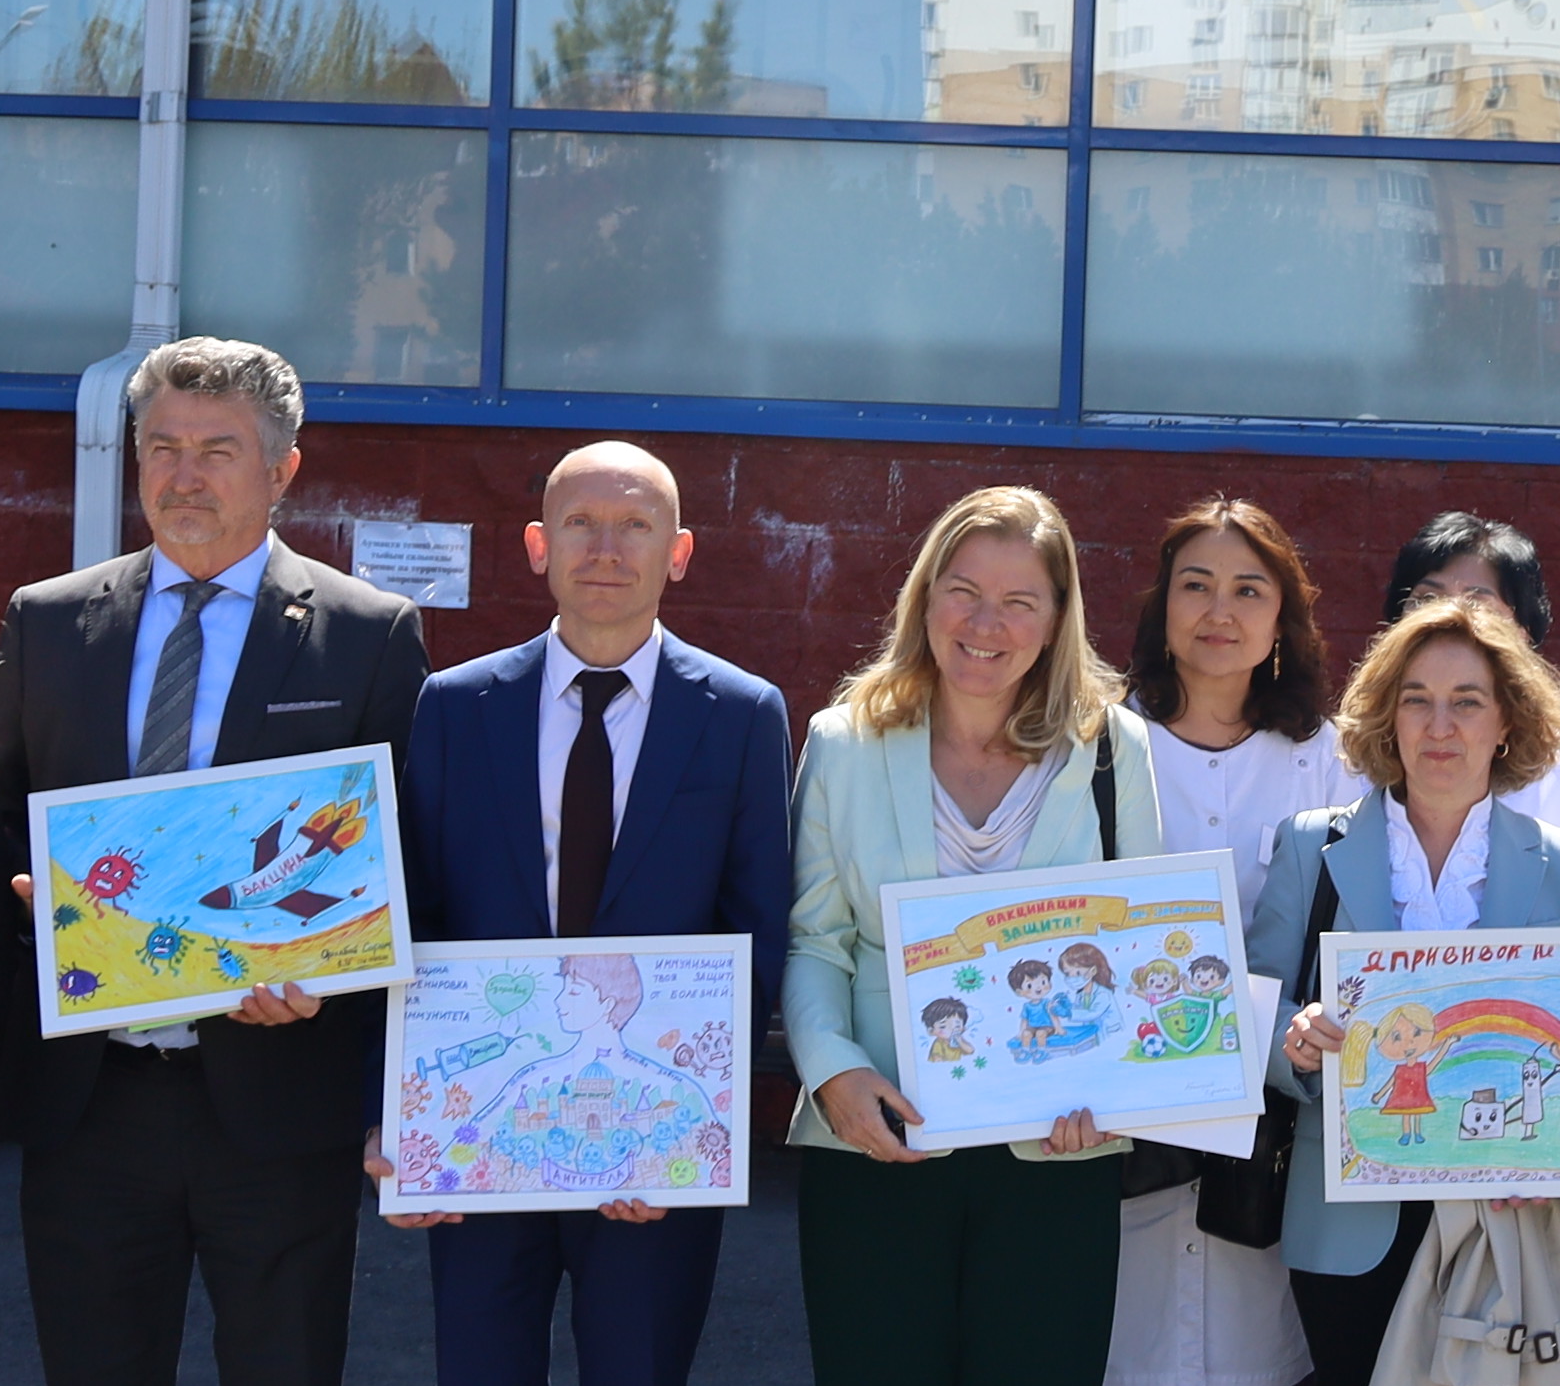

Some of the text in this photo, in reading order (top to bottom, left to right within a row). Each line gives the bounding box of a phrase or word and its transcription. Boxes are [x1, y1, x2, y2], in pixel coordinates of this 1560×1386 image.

[240, 852, 308, 897] ВАКЦИНА
[985, 896, 1088, 928] ВАКЦИНАЦИЯ
[1001, 915, 1083, 944] ЗАЩИТА!
[415, 965, 449, 978] КЦИНА
[552, 1168, 627, 1187] АНТИТЕЛА
